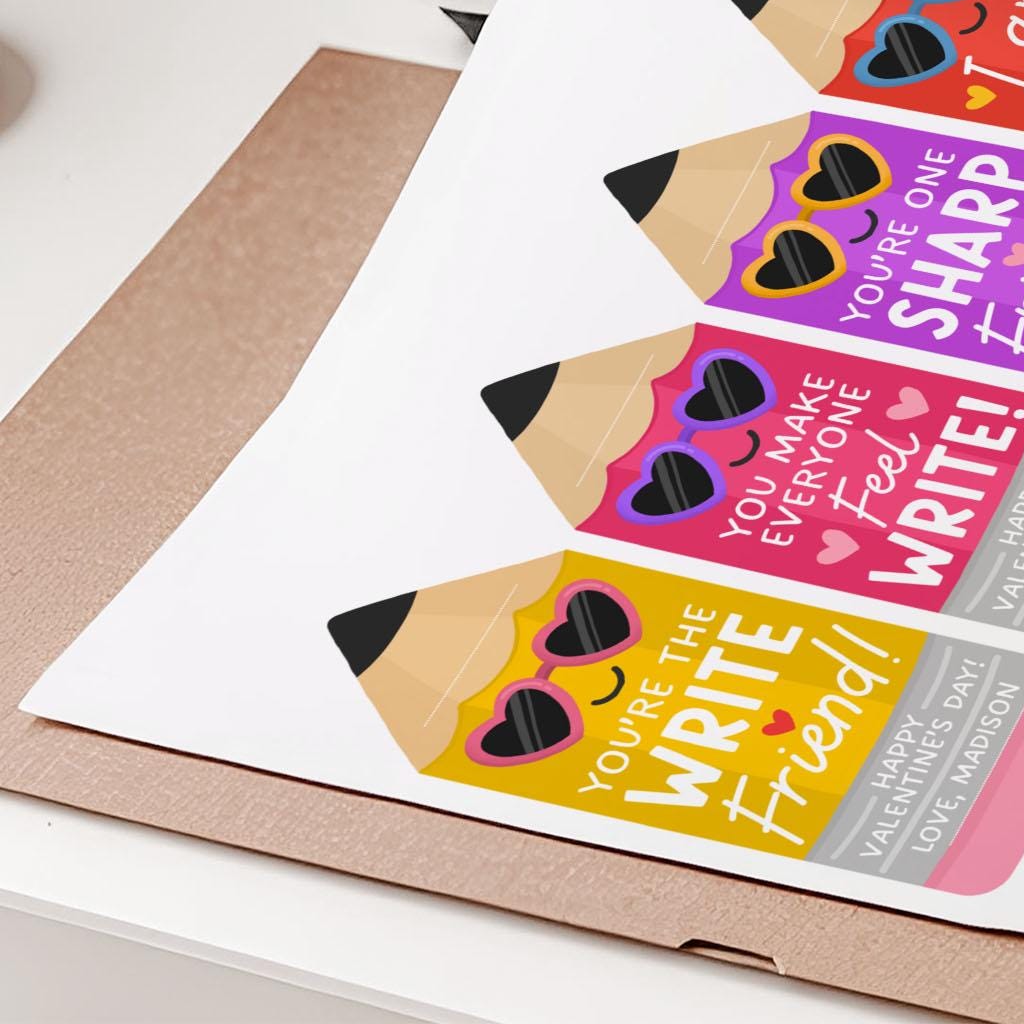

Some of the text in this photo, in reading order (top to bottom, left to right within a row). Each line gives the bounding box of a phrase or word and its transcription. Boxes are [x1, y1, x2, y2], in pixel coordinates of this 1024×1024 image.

[839, 148, 957, 323] YOU'RE ONE
[719, 373, 835, 541] YOU MAKE
[761, 384, 871, 546] EVERYONE
[828, 428, 921, 529] Feel
[577, 604, 716, 794] YOU'RE THE
[624, 613, 803, 809] WRITE
[722, 623, 901, 845] Friend!
[859, 657, 986, 858] VALENTINE'S DAY!
[871, 714, 926, 789] HAPPY
[912, 681, 1020, 852] LOVE, MADISON
